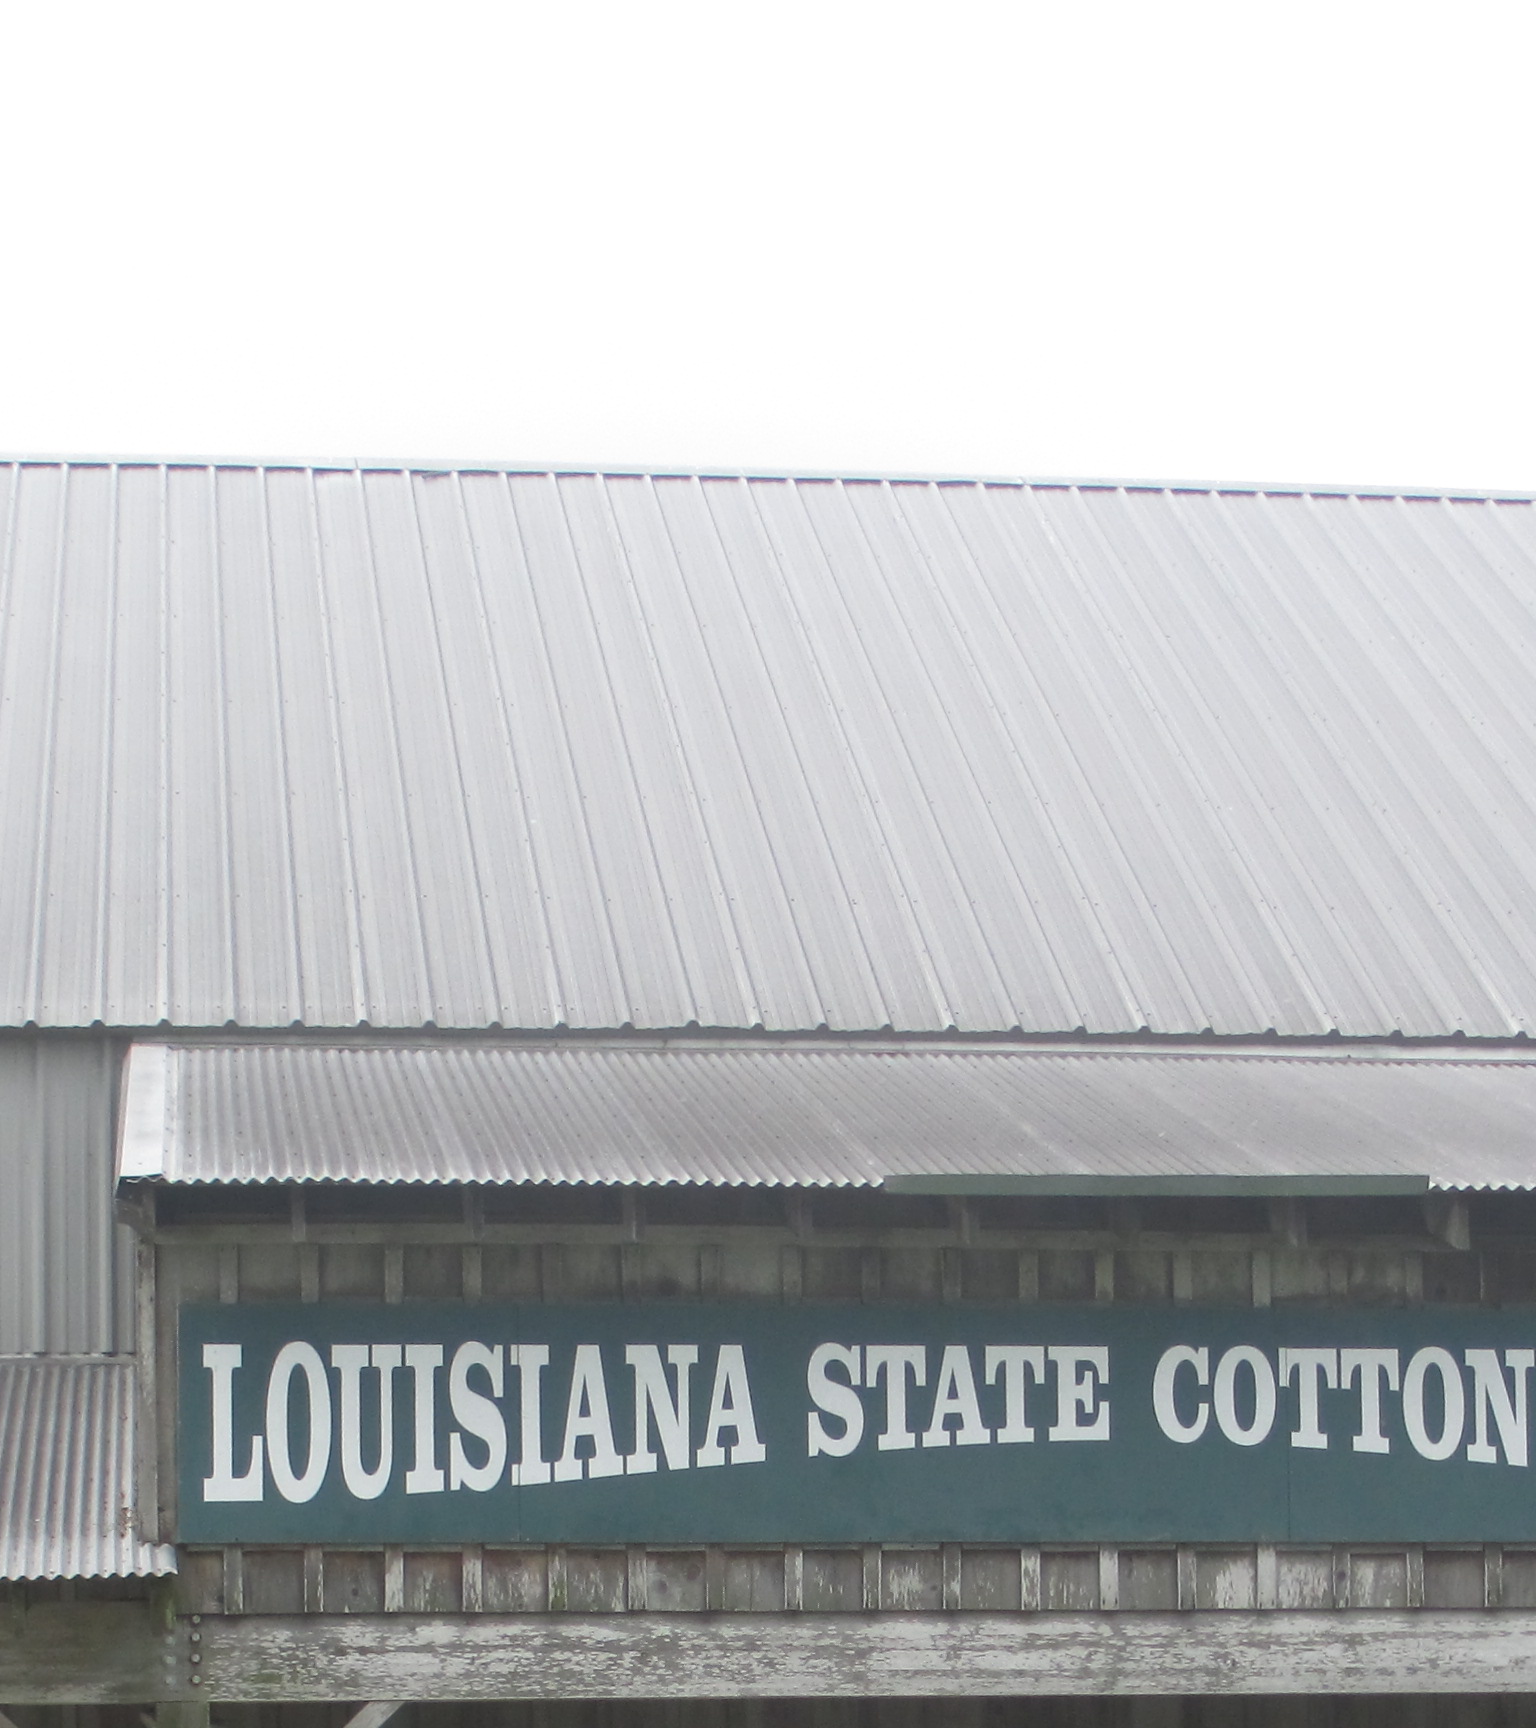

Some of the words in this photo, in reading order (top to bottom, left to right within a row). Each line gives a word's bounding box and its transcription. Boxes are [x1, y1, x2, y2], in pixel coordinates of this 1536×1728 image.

[202, 1341, 766, 1504] LOUISIANA
[807, 1342, 1110, 1457] STATE
[1152, 1345, 1535, 1467] COTTON
